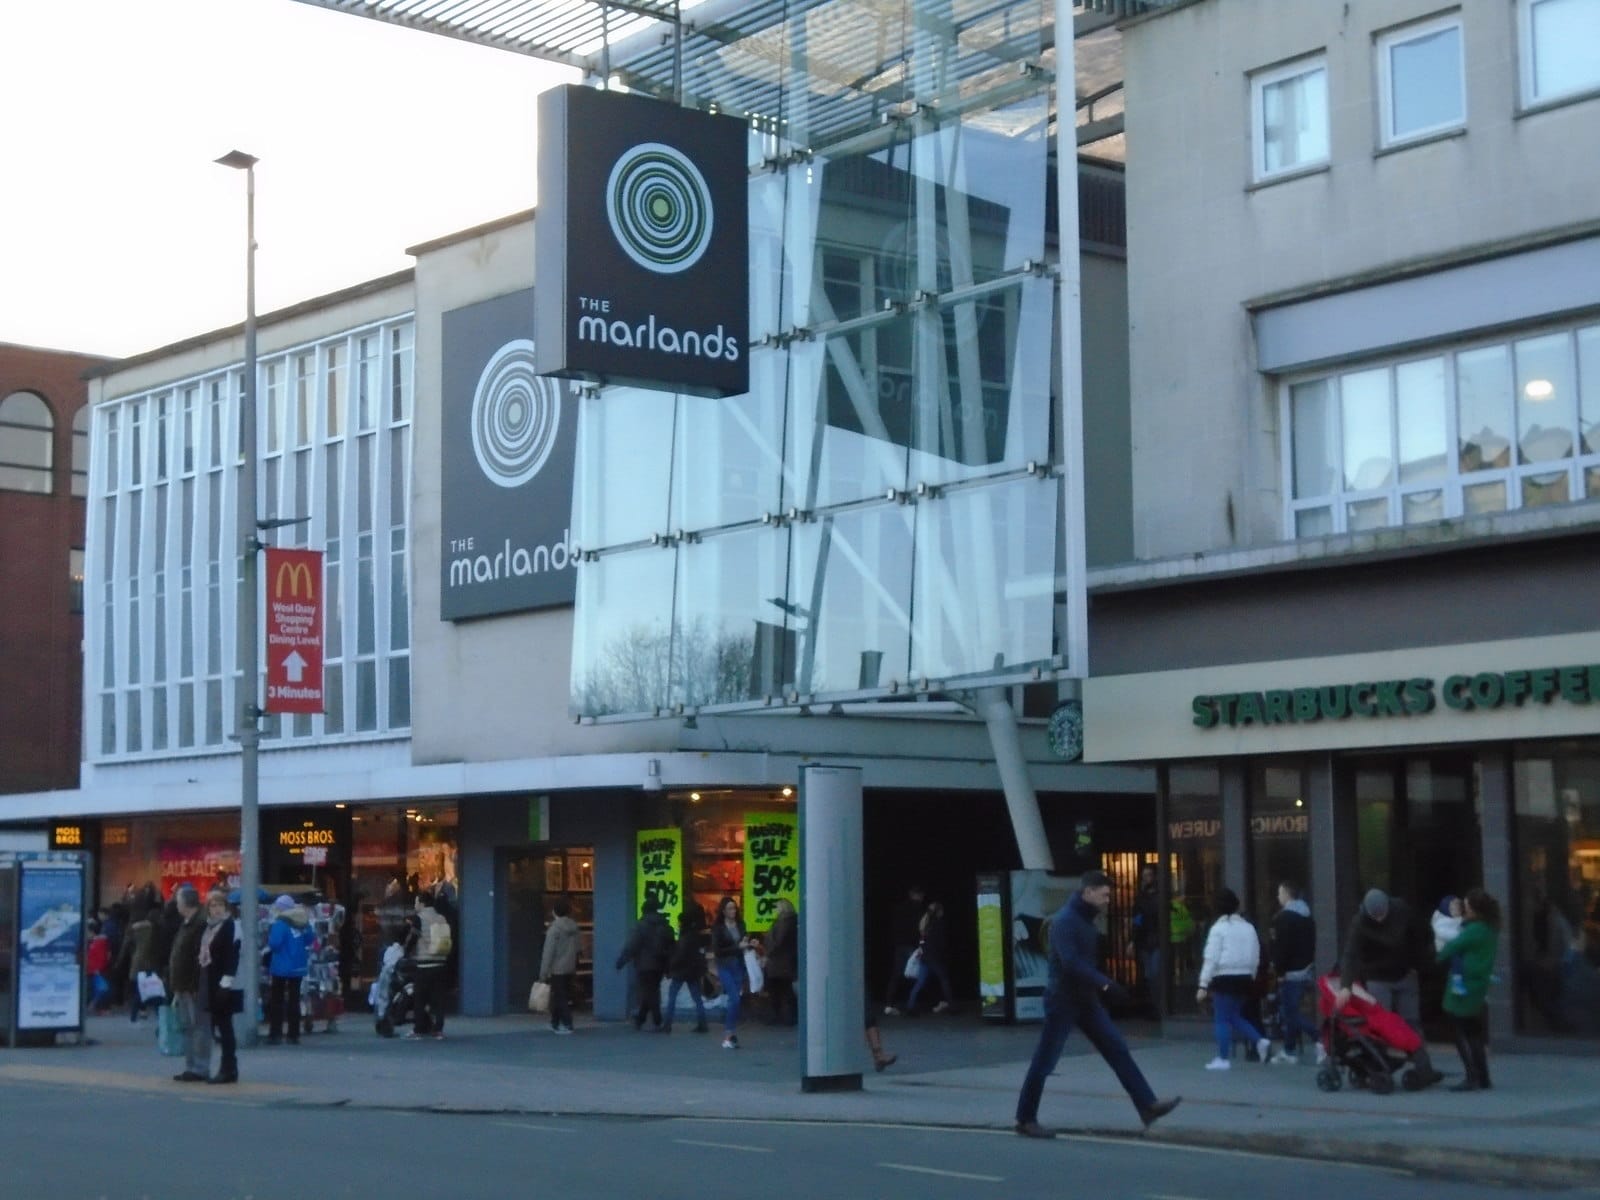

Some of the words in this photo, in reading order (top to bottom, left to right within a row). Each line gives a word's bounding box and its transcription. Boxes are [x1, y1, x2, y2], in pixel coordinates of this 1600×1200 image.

[579, 296, 610, 312] THE
[578, 314, 739, 361] marlands
[450, 536, 475, 553] THE
[275, 613, 314, 626] Shopping
[269, 634, 296, 646] Dining
[268, 685, 276, 698] 3
[277, 685, 321, 699] Minutes
[1192, 677, 1435, 729] STARBUCKS
[279, 831, 306, 845] MOSS
[750, 838, 790, 860] SALE
[161, 860, 187, 877] SALE
[190, 859, 217, 877] SALE
[642, 852, 673, 875] SALE
[753, 865, 797, 897] 50%
[757, 898, 781, 915] OF
